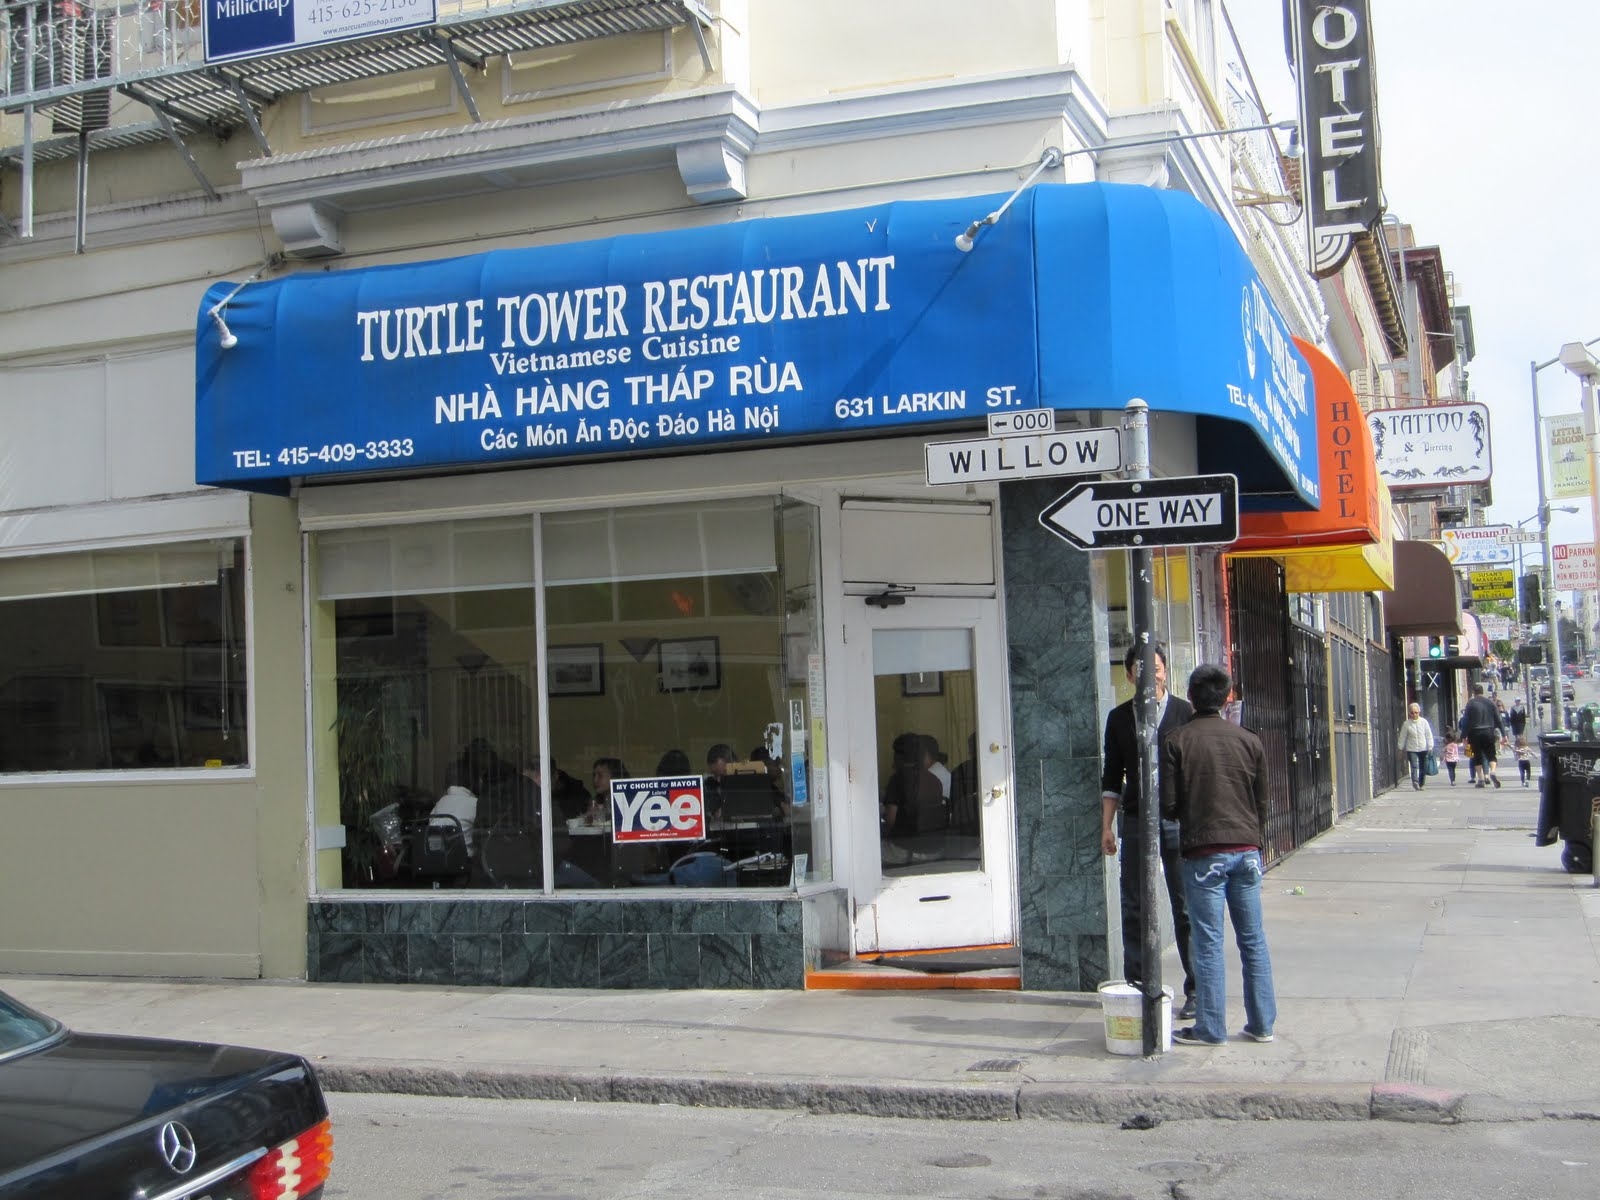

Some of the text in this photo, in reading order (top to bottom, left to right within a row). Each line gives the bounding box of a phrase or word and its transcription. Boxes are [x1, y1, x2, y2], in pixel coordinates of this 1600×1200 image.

[323, 16, 403, 35] www.marcusmillichap.com
[358, 256, 894, 361] TURTLE TOWER RESTAURANT
[490, 334, 740, 375] Vietnamese Cuisine
[436, 357, 803, 424] NHÀ HÀNG THÁP RÙA
[836, 386, 1021, 418] 631 LARKIN ST.
[481, 405, 779, 450] Các Món Ăn Độc Đáo Hà Nội
[1013, 412, 1048, 430] 000
[1389, 411, 1463, 436] TATTOO
[1552, 426, 1582, 437] LITTLE
[233, 439, 414, 468] TEL: 415-409-3333
[950, 440, 1099, 474] WILLOW
[1331, 402, 1355, 517] HOTEL
[1404, 442, 1414, 452] &
[1097, 498, 1213, 528] ONE WAY
[1454, 530, 1500, 540] Vietnam
[1500, 534, 1536, 542] ELLIS
[1554, 546, 1566, 558] NO
[614, 791, 700, 832] Yee
